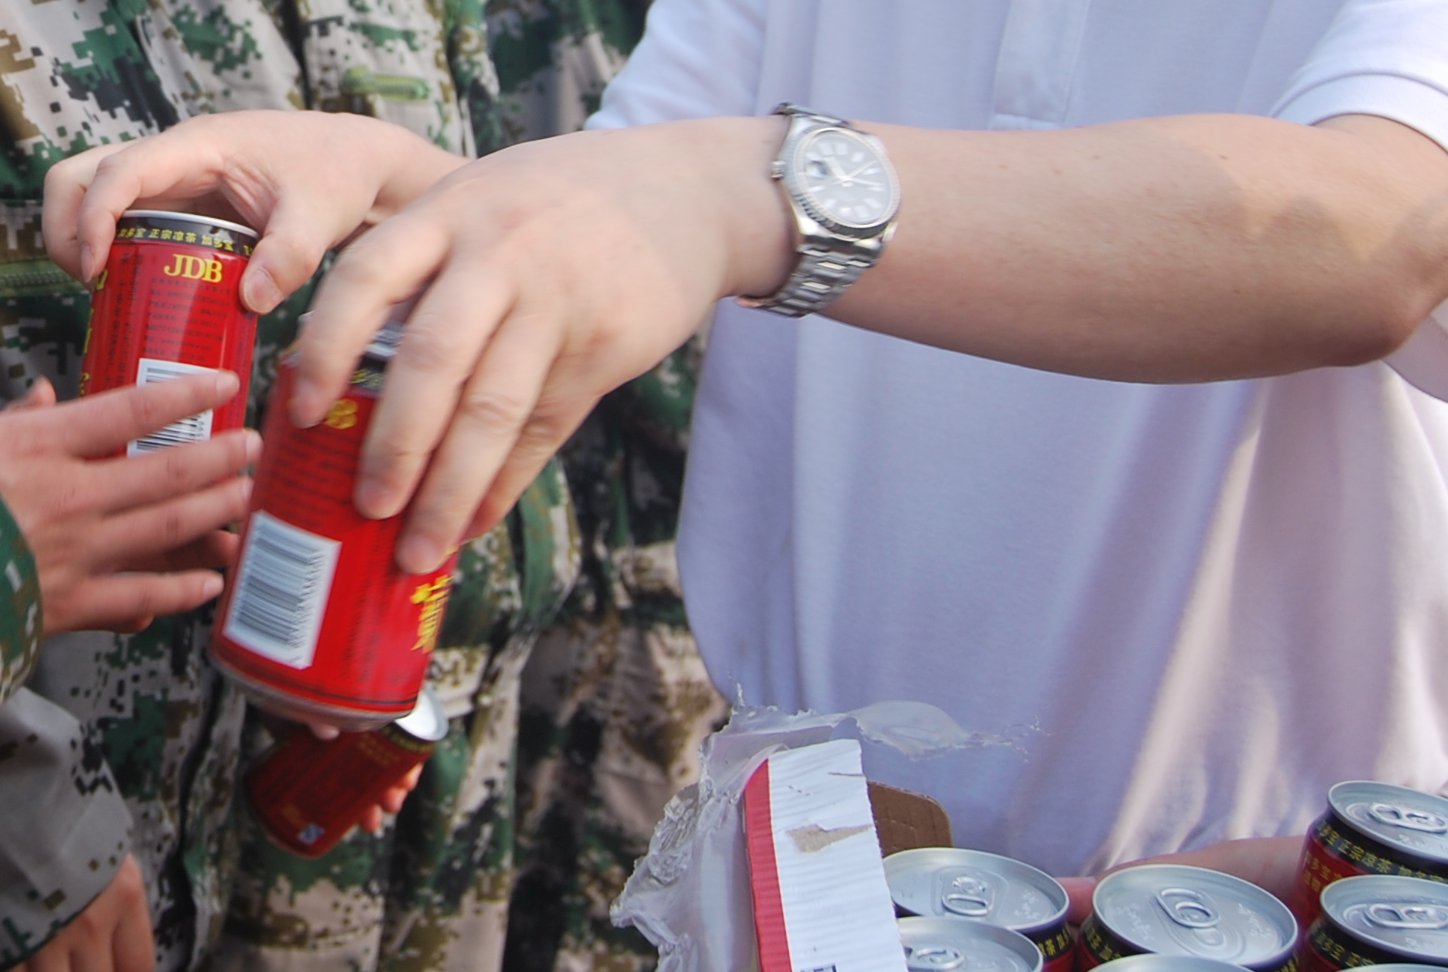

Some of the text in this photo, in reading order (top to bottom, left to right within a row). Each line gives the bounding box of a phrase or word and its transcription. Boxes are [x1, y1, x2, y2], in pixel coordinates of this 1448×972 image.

[149, 228, 198, 244] 正宗凉茶
[201, 234, 234, 252] 加多宝
[163, 253, 223, 284] JDB
[1338, 839, 1393, 874] 正宗凉茶
